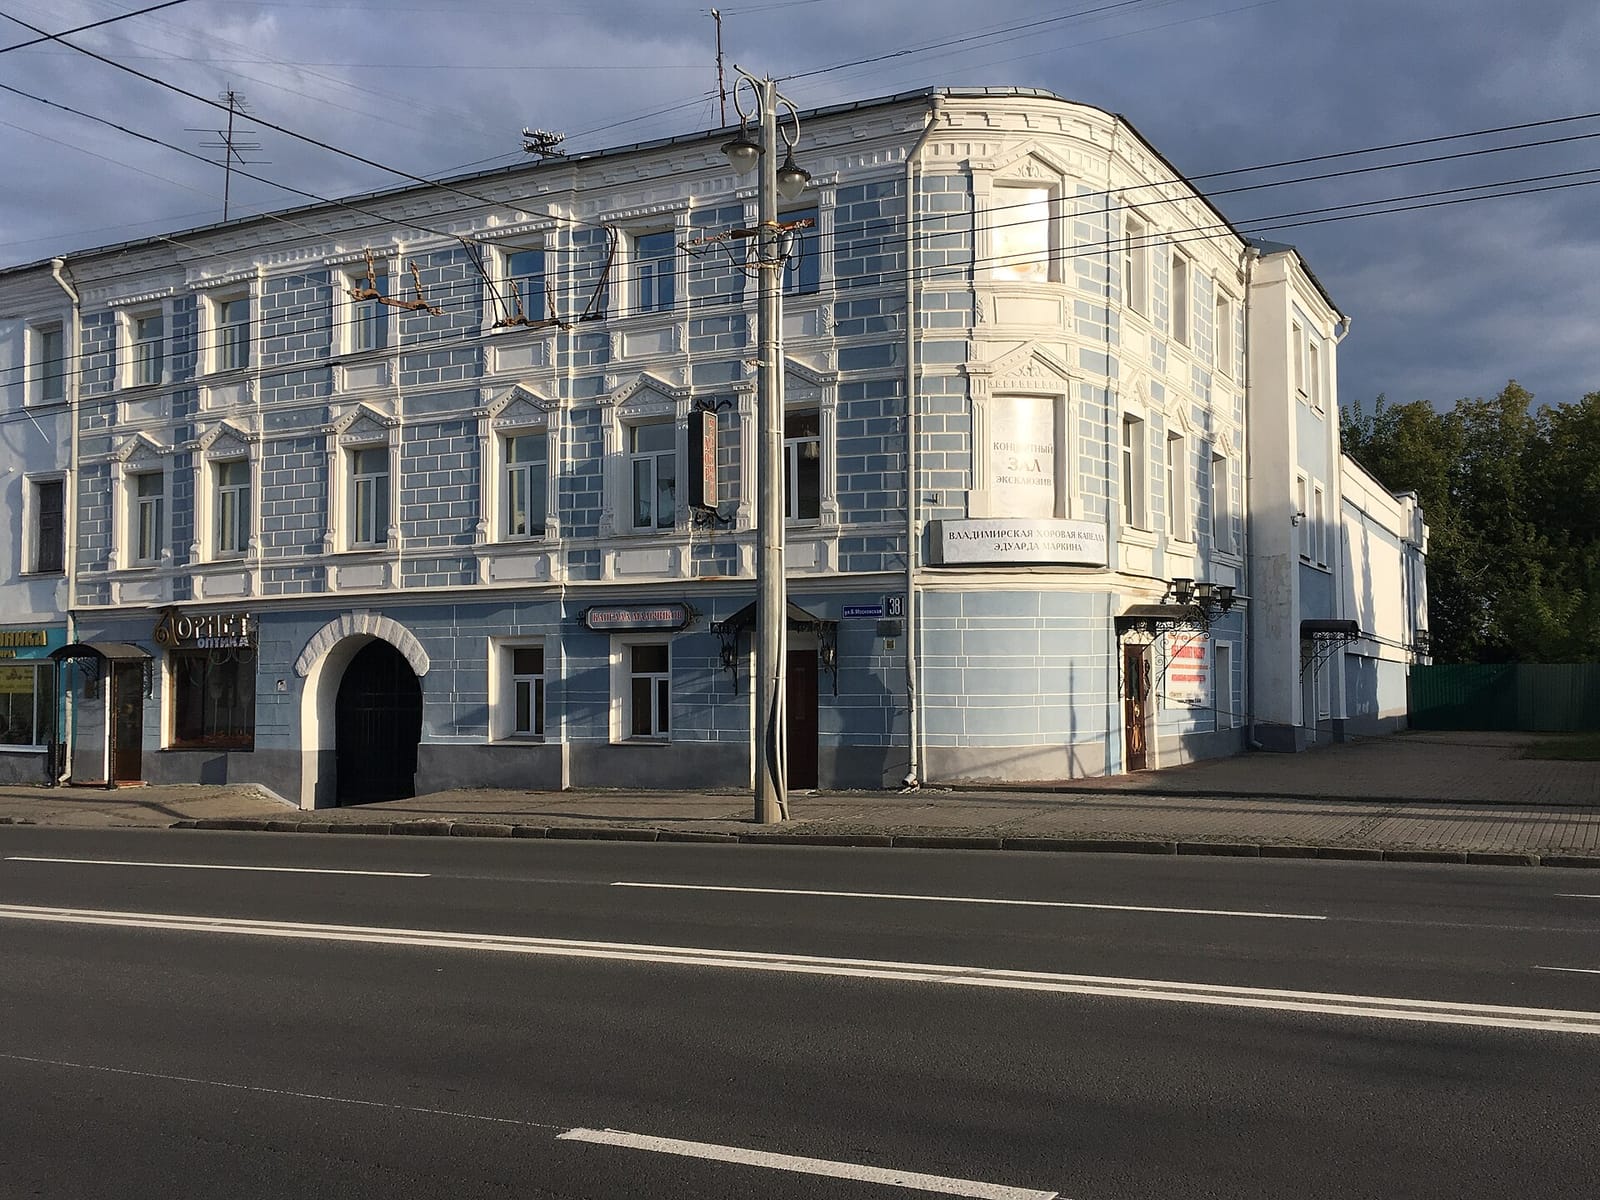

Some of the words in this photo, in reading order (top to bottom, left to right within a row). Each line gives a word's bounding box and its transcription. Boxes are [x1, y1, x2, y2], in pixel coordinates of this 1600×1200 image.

[993, 441, 1053, 454] КОНТНЫЙ
[949, 529, 1033, 541] ВЛАДИМИРСКАЯ
[1036, 529, 1076, 540] ХОРОВАЯ
[994, 542, 1040, 552] ЭДУАРДА
[1043, 542, 1083, 552] МАРКИНА
[889, 598, 901, 615] 38
[197, 636, 249, 649] ОПТИКА
